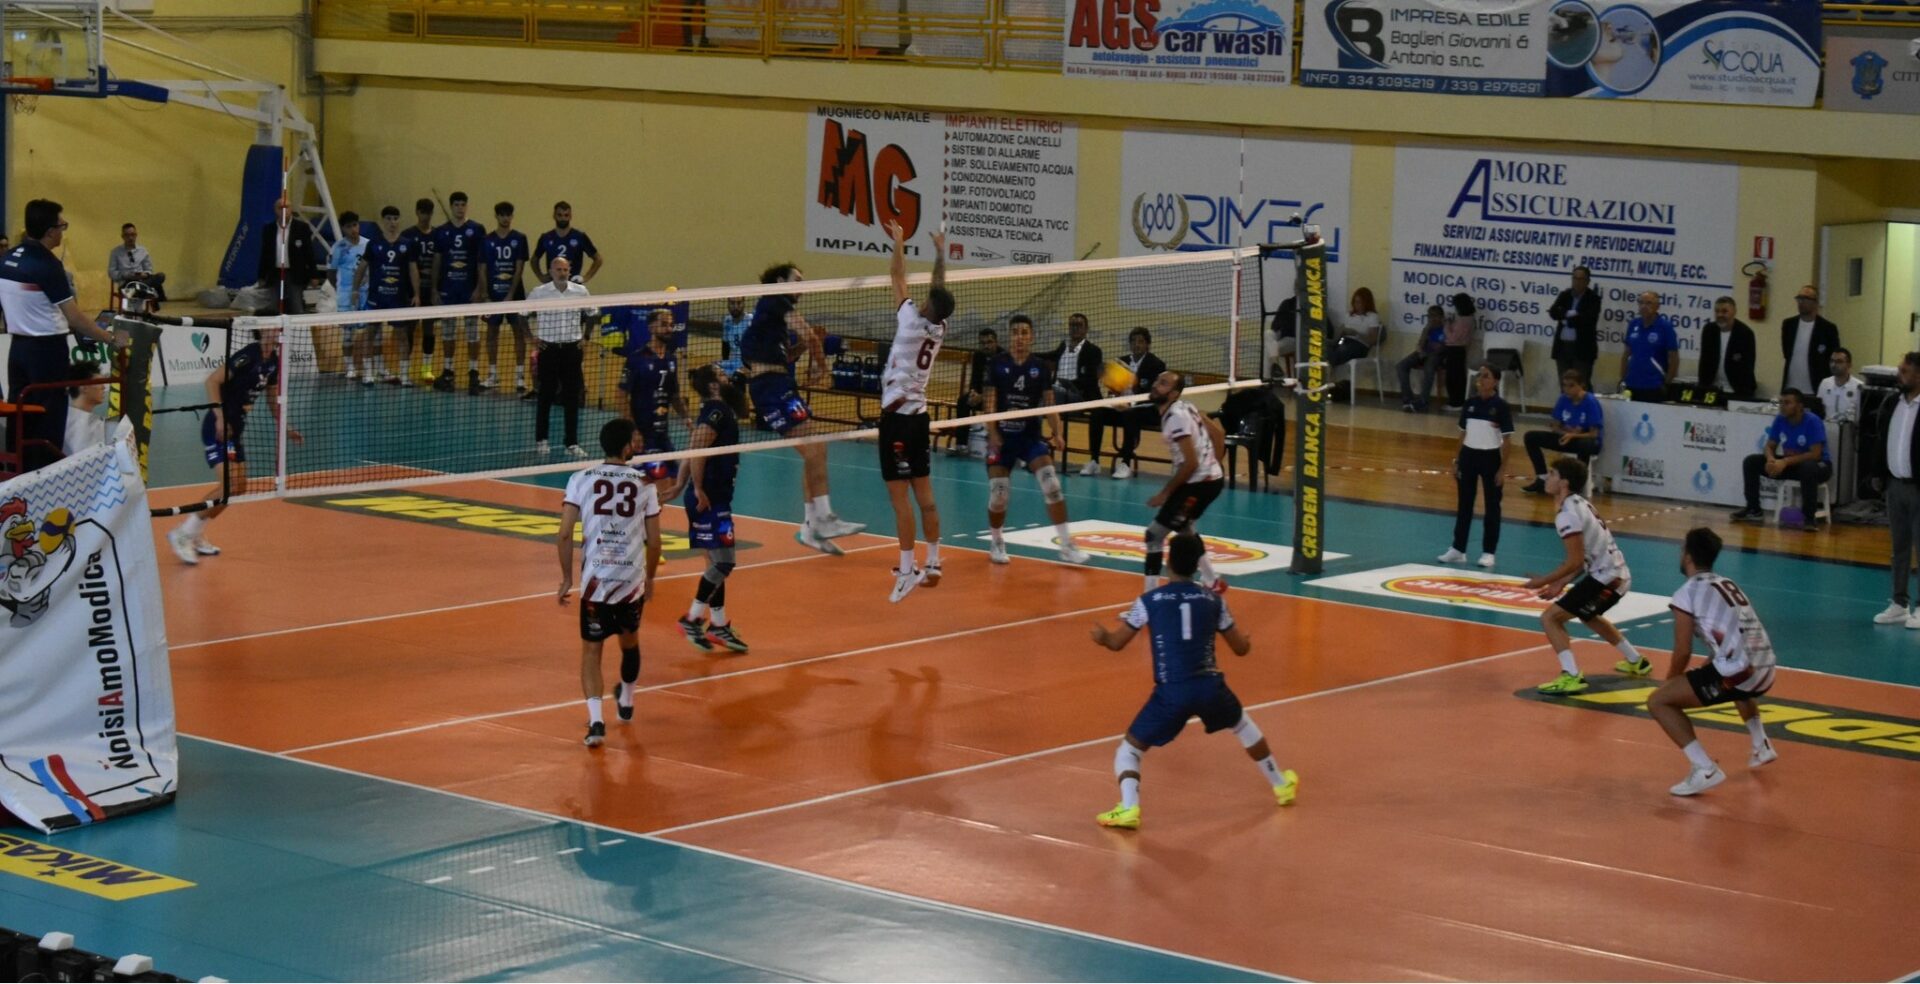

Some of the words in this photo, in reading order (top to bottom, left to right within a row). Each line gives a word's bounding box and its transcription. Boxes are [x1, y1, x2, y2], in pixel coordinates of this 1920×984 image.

[1068, 0, 1161, 52] AGS
[1390, 8, 1474, 26] IMPRESA
[1476, 13, 1530, 27] EDILE
[1164, 31, 1207, 52] car
[1213, 30, 1283, 56] wash
[1391, 31, 1445, 48] Baglieri
[1449, 33, 1511, 49] Giovanni
[1388, 50, 1444, 67] Antonio
[1448, 55, 1484, 68] s.n.c.
[1305, 72, 1339, 85] INFO
[1348, 75, 1373, 87] 334
[1377, 76, 1434, 90] 3095219
[1451, 80, 1479, 91] 339
[816, 106, 880, 120] MUGNIECO
[884, 111, 930, 123] NATALE
[945, 114, 997, 129] IMPIANTI
[1000, 117, 1063, 133] ELETTRICI
[951, 131, 1015, 145] AUTOMAZIONE
[1017, 134, 1061, 147] CANCELLI
[951, 144, 986, 156] SISTEMI
[988, 147, 997, 157] DI
[998, 148, 1040, 160] ALLARME
[951, 158, 967, 168] IMP.
[970, 159, 1040, 173] SOLLEVAMENTO
[1041, 164, 1074, 176] ACQUA
[817, 118, 922, 242] MG
[951, 171, 1036, 187] CONDIZIONAMENTO
[950, 185, 967, 195] IMP.
[969, 186, 1036, 201] FOTOVOLTAICO
[950, 199, 987, 210] IMPIANTI
[989, 201, 1032, 215] DOMOTICI
[950, 212, 1043, 229] VIDEOSORVEGLIANZA
[1045, 219, 1069, 231] TVCC
[454, 235, 463, 248] 5
[949, 225, 1003, 239] ASSISTENZA
[1005, 229, 1044, 242] TECNICA
[1443, 225, 1486, 241] SERVIZI
[1488, 229, 1572, 248] ASSICURATIVI
[1573, 236, 1582, 248] E
[1585, 236, 1676, 256] PREVIDENZIALI
[386, 250, 396, 263] 9
[495, 246, 512, 259] 10
[557, 245, 567, 257] 2
[1012, 251, 1051, 263] caprari
[1413, 242, 1500, 263] FINANZIAMENTI:
[1502, 250, 1559, 267] CESSIONE
[1581, 255, 1634, 276] PRESTITI,
[1637, 260, 1677, 279] MUTUI,
[1680, 264, 1708, 280] ECC.
[1305, 257, 1323, 320] BANCA
[1403, 271, 1467, 289] MODICA
[1471, 277, 1506, 294] (RG)
[1520, 280, 1560, 296] Viale
[1687, 294, 1712, 309] 7/a
[1404, 292, 1430, 305] tel.
[1436, 294, 1541, 315] 09906565
[916, 337, 936, 371] 6
[1307, 328, 1323, 402] CREDEM
[1013, 374, 1026, 391] 4
[1303, 413, 1321, 478] BANCA
[592, 478, 638, 518] 23
[1302, 485, 1319, 559] CREDEM
[1710, 579, 1749, 608] 18
[1178, 602, 1192, 640] 1
[78, 549, 139, 770] NoisiAmoModica
